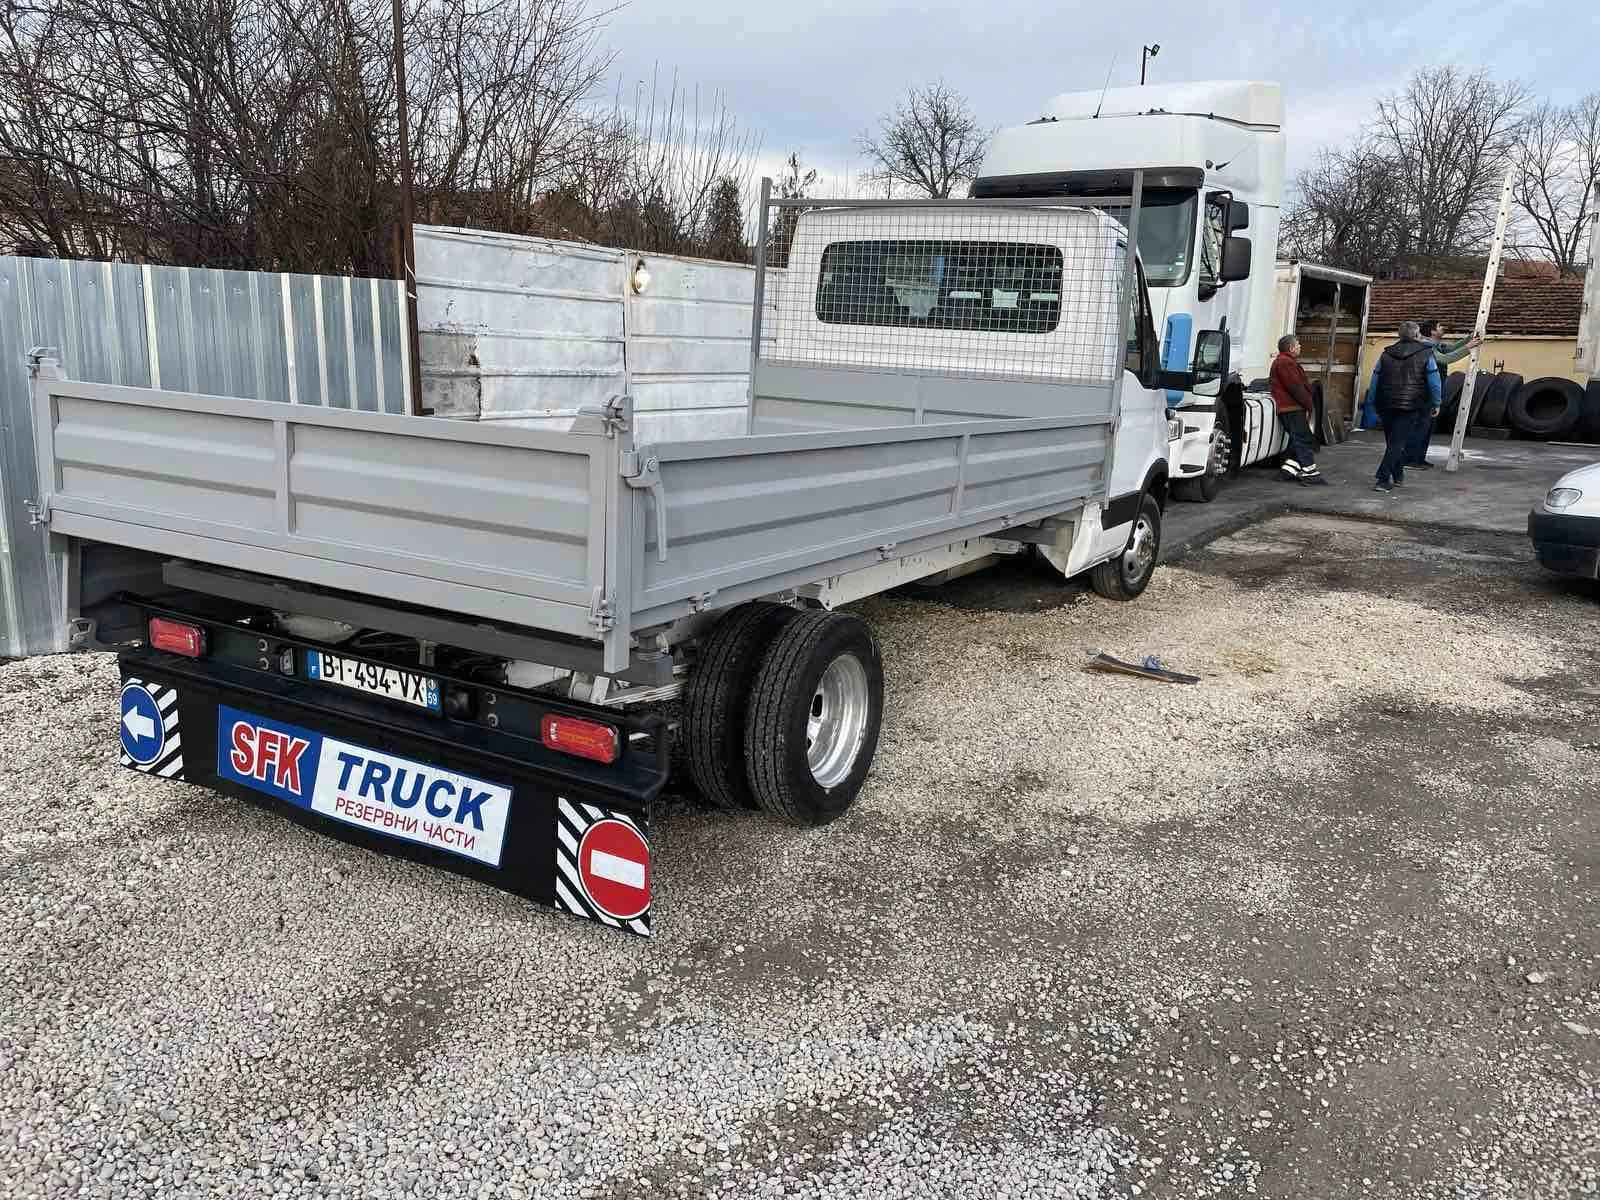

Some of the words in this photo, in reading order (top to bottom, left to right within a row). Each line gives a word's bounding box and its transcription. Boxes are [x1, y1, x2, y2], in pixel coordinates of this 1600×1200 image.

[427, 691, 438, 705] 59
[230, 720, 310, 796] SFK
[335, 797, 419, 834] РЕЗЕРВНИ
[422, 822, 476, 851] ЧАСТИ
[337, 752, 494, 832] TRUCK
